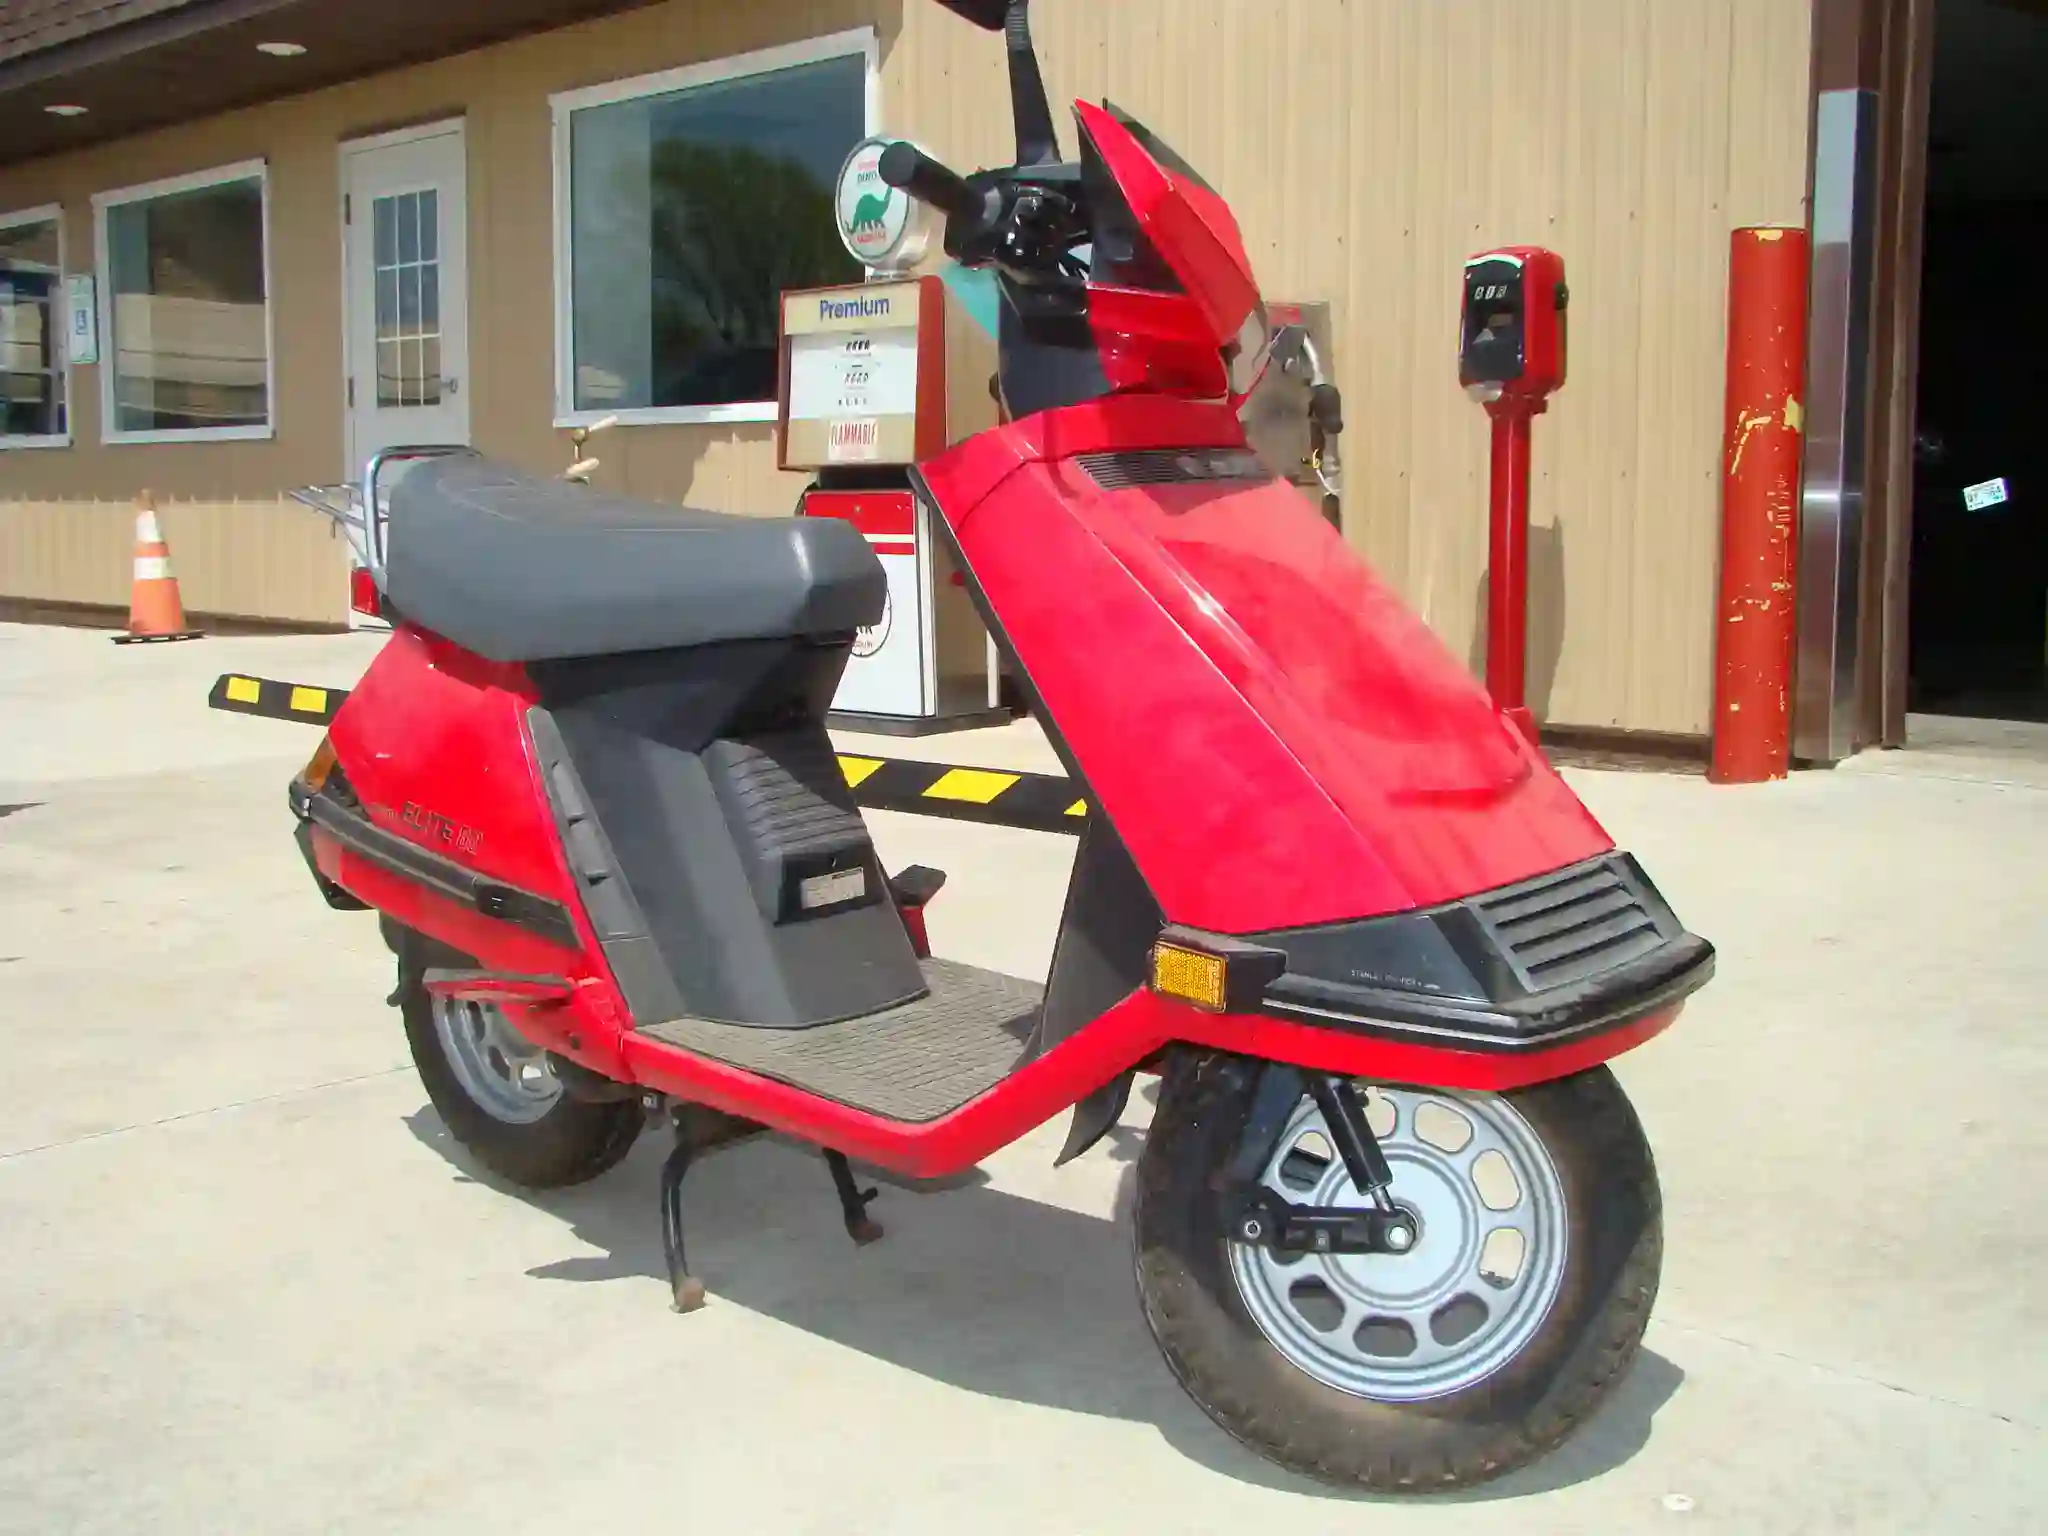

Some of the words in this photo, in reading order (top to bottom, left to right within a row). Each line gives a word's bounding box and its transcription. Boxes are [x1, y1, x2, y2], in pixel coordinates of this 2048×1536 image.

[819, 295, 890, 322] Premium
[831, 422, 876, 446] FLAMMABLE
[403, 801, 454, 842] ELITE
